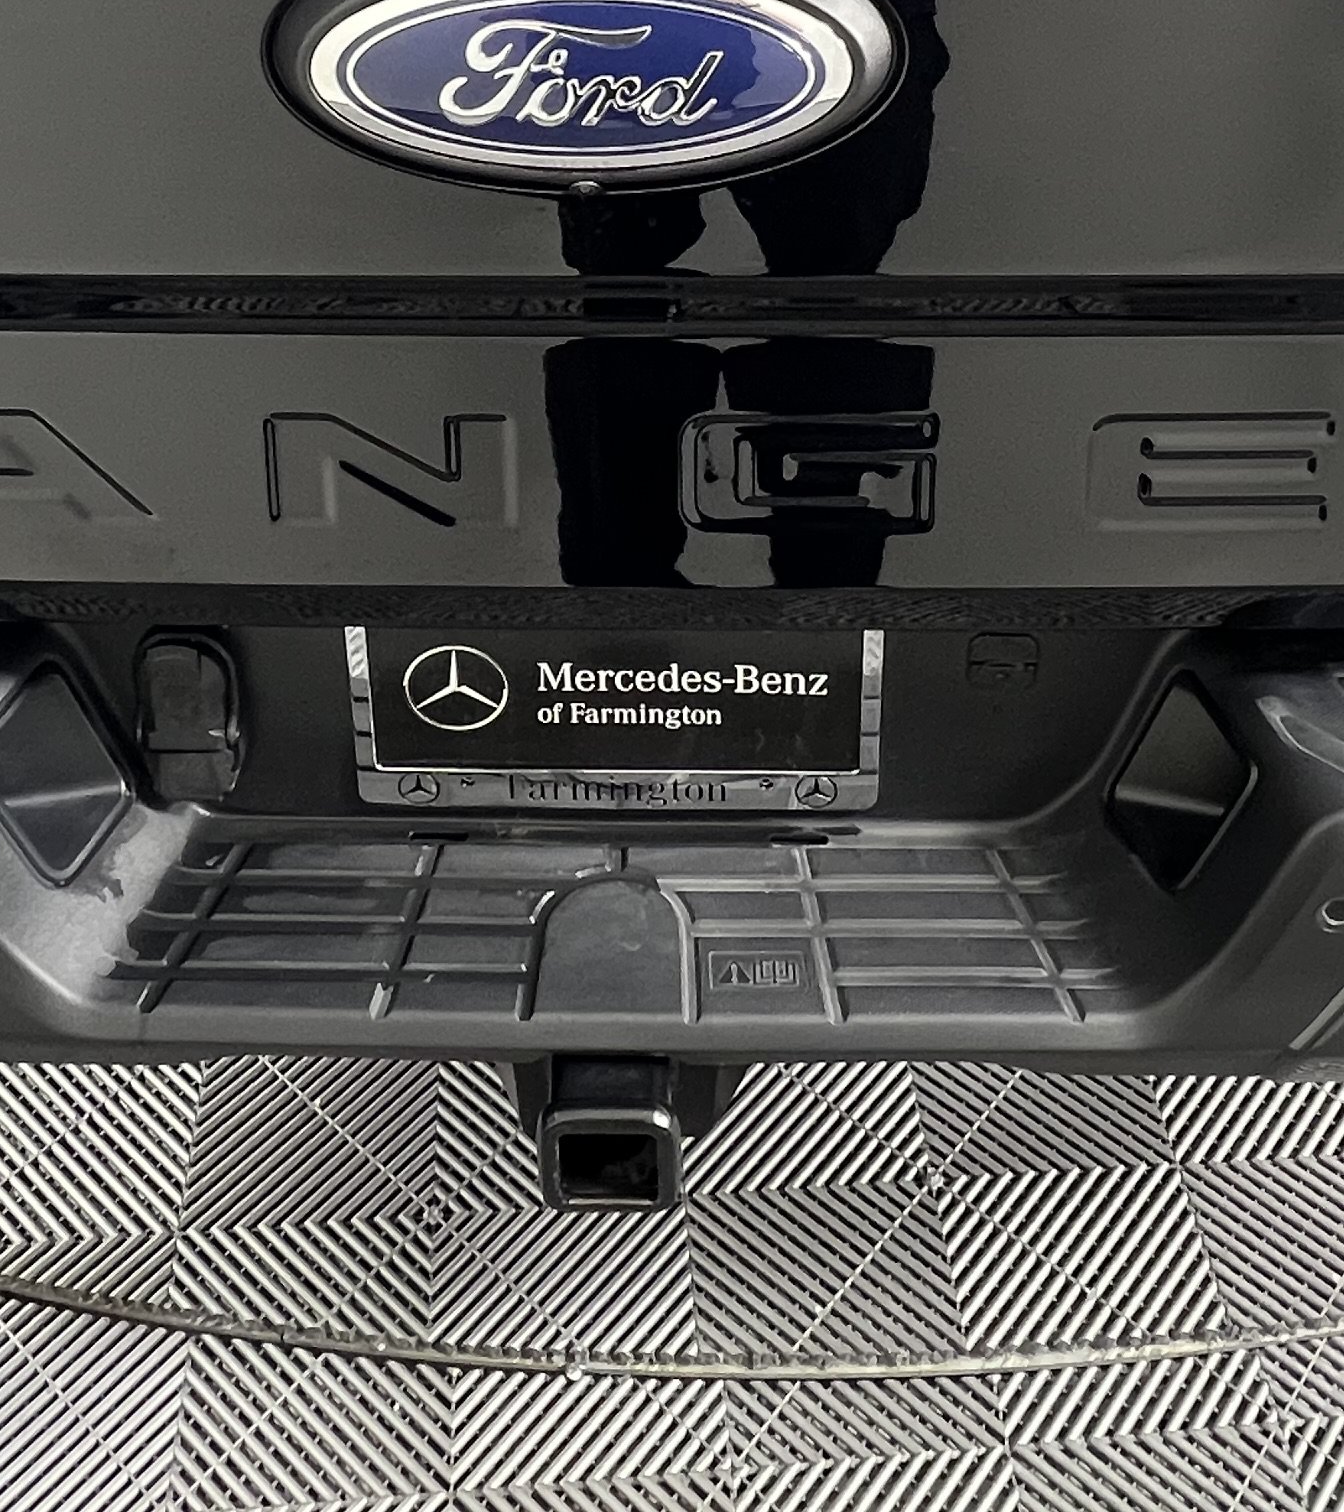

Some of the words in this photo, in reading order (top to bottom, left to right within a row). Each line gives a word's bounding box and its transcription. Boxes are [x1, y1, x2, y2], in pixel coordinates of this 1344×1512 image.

[439, 19, 725, 128] Ford
[536, 661, 829, 697] Mercedes-Benz
[536, 702, 562, 725] of
[569, 702, 723, 730] Farmington
